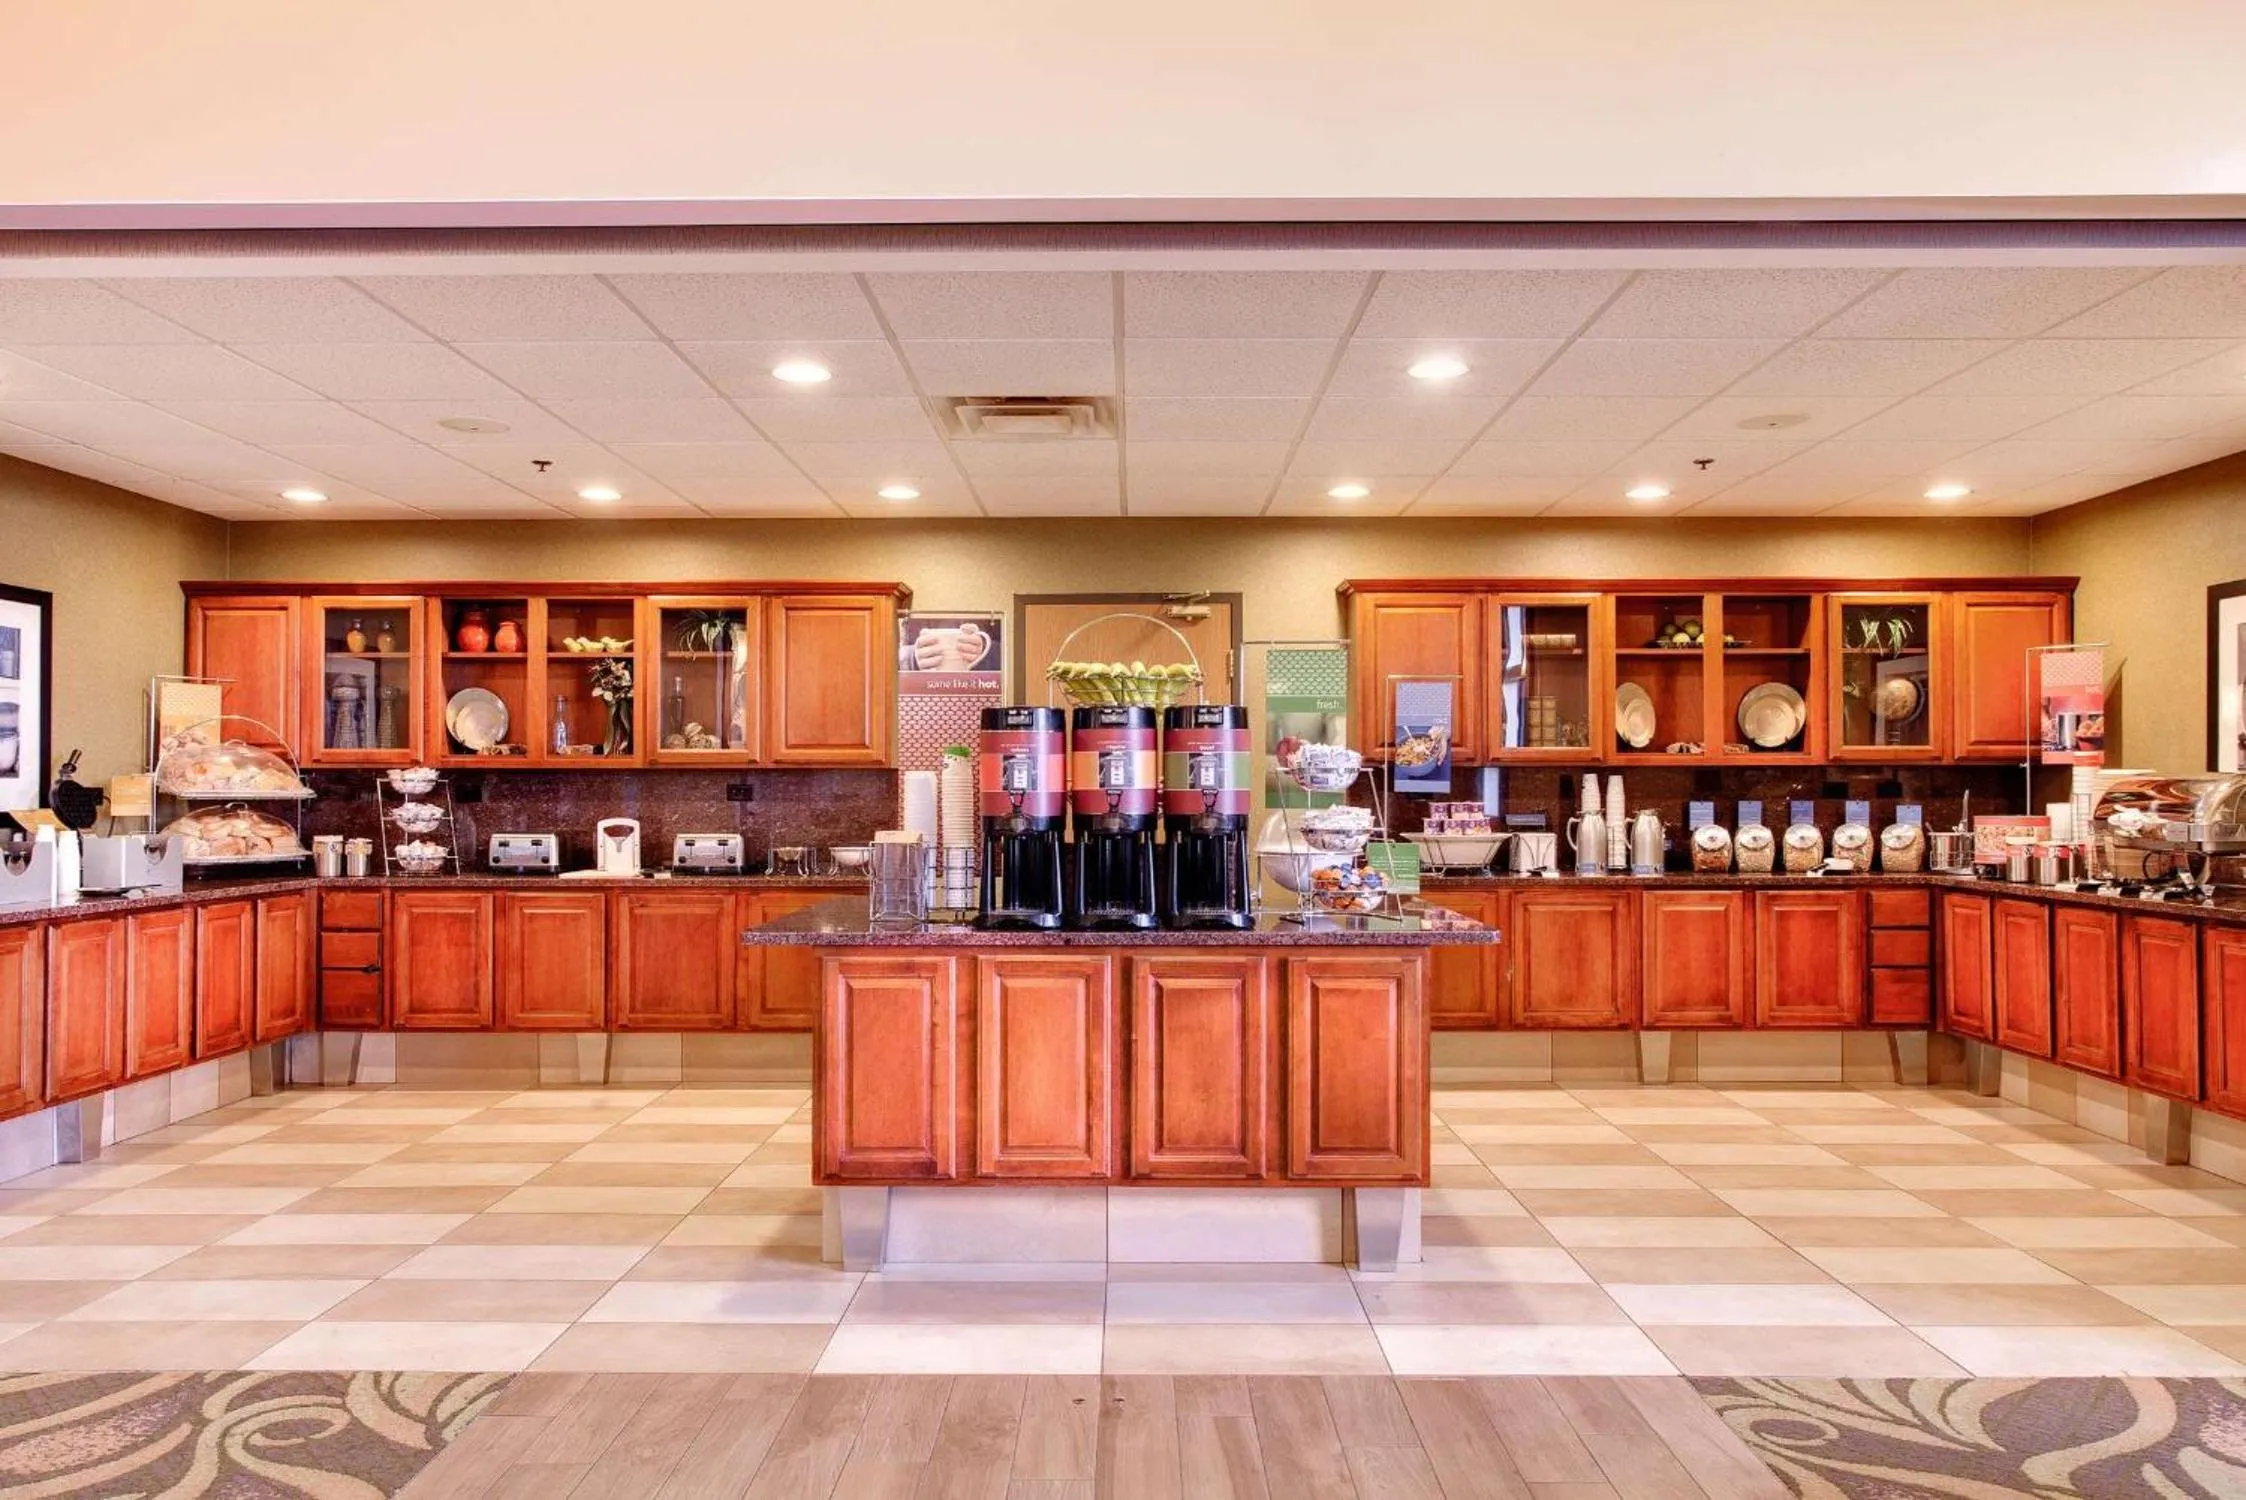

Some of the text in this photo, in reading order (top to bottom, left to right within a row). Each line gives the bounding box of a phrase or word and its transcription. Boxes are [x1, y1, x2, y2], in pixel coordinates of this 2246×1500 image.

[926, 680, 950, 689] some
[952, 678, 968, 689] like
[978, 678, 1000, 690] hot.
